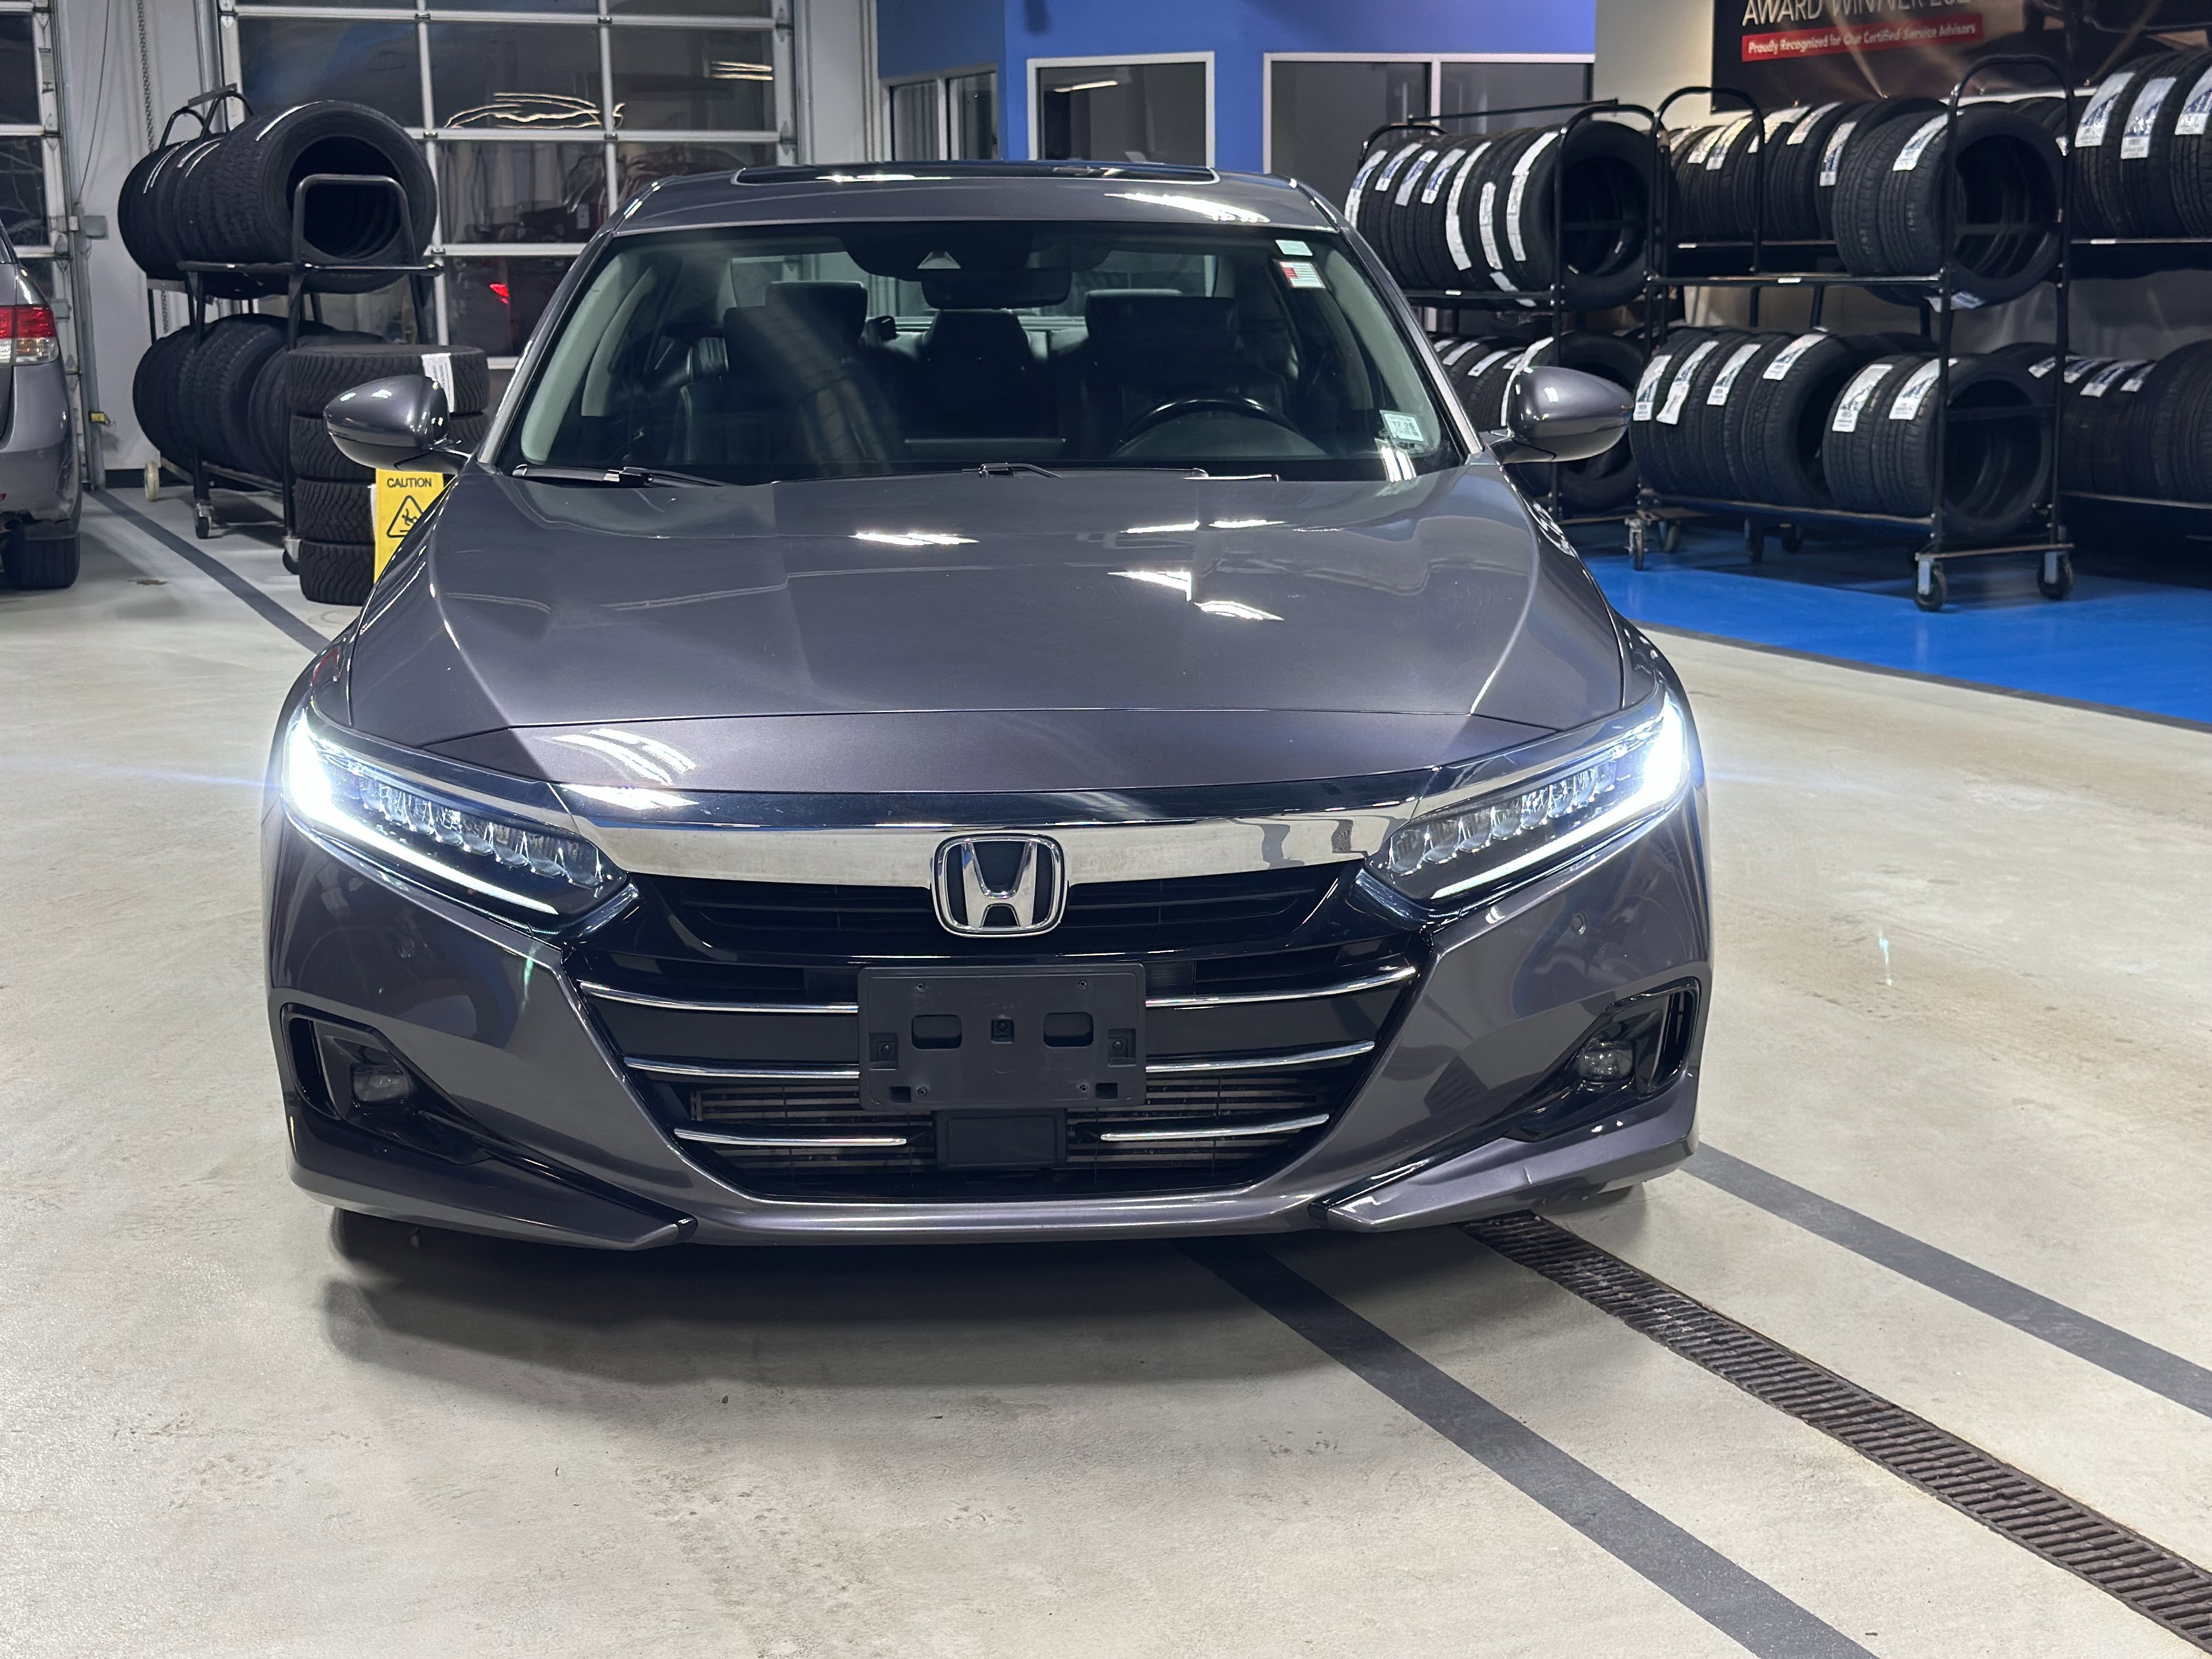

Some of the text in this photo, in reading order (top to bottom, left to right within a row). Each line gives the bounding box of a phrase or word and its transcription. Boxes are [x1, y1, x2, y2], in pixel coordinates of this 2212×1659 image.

[1742, 0, 1923, 26] AWARD WIN
[1748, 24, 1976, 55] Proudly Recognized for Our Certified Service Advisors
[387, 477, 432, 488] CAUTION
